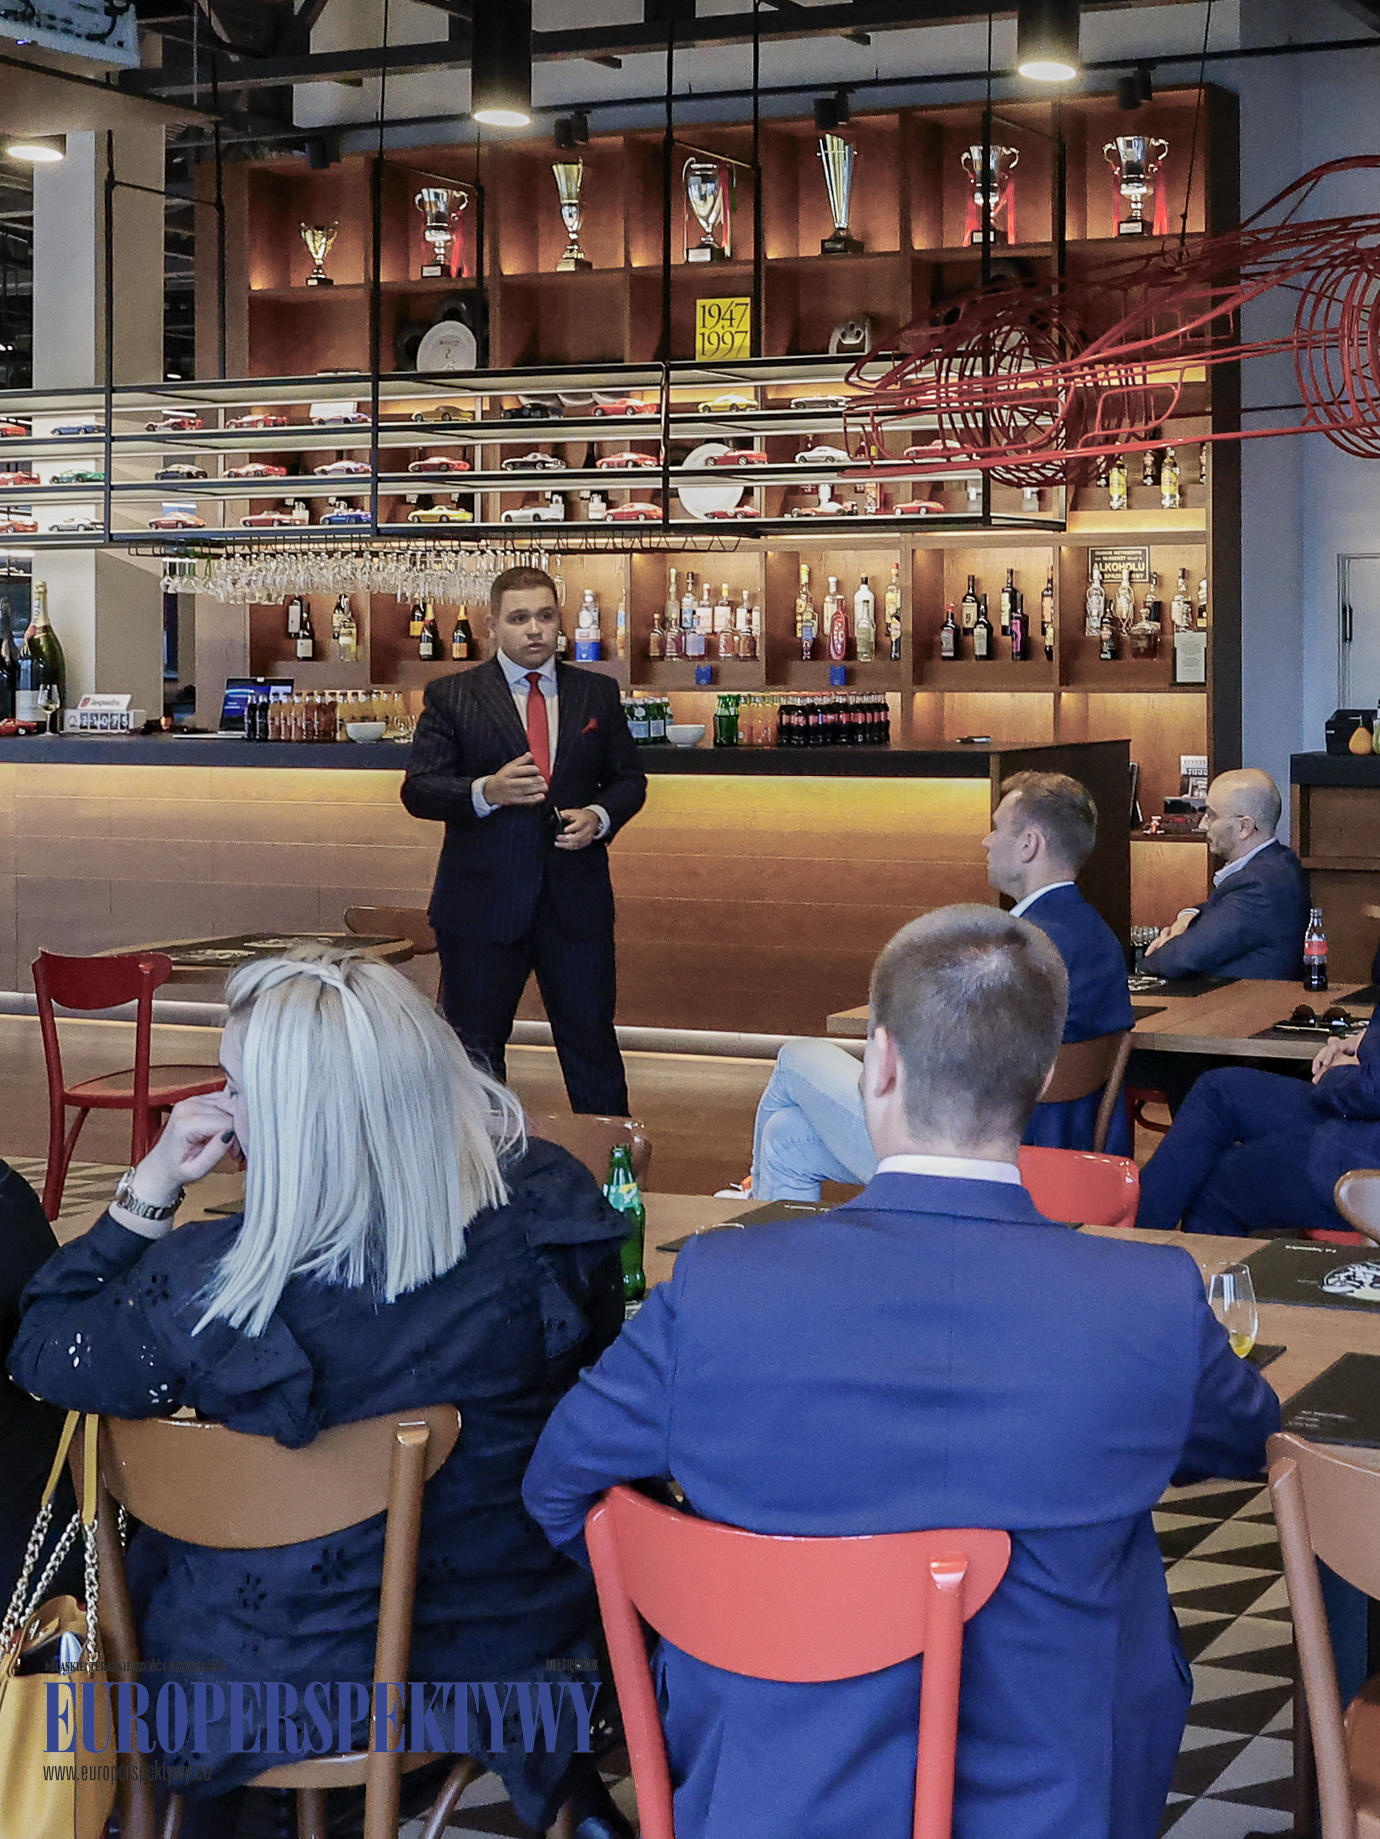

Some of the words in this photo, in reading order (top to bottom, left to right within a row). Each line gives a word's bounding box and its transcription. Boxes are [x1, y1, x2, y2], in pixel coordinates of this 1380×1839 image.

[700, 300, 750, 331] 1947
[699, 330, 749, 358] 1997
[1093, 562, 1146, 572] ALKOHOLU
